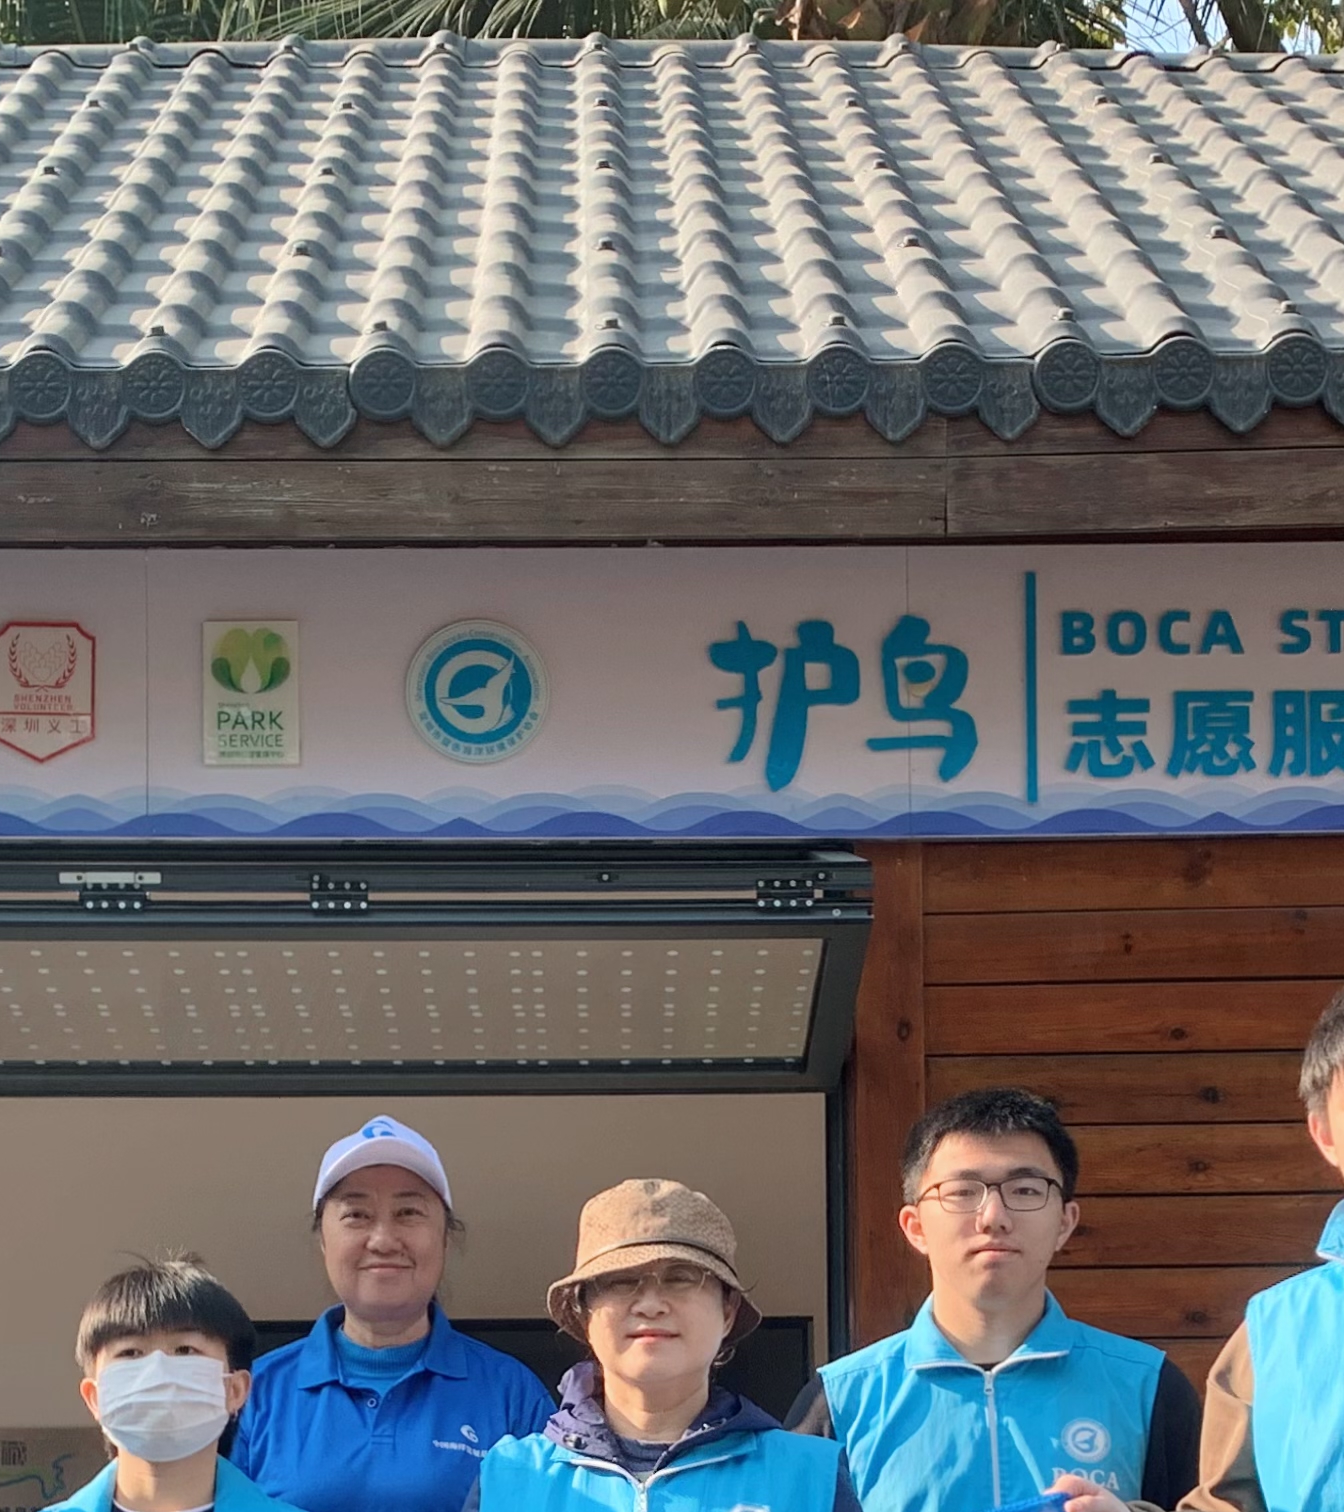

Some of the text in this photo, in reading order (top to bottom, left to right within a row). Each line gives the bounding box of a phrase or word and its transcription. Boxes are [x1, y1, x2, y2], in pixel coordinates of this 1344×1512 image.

[1060, 609, 1244, 656] BOCA
[14, 694, 72, 704] SHENZHEN
[709, 614, 978, 790] 护鸟
[1, 717, 82, 734] 深圳义工
[217, 711, 284, 730] PARK
[218, 734, 284, 747] SERVICE
